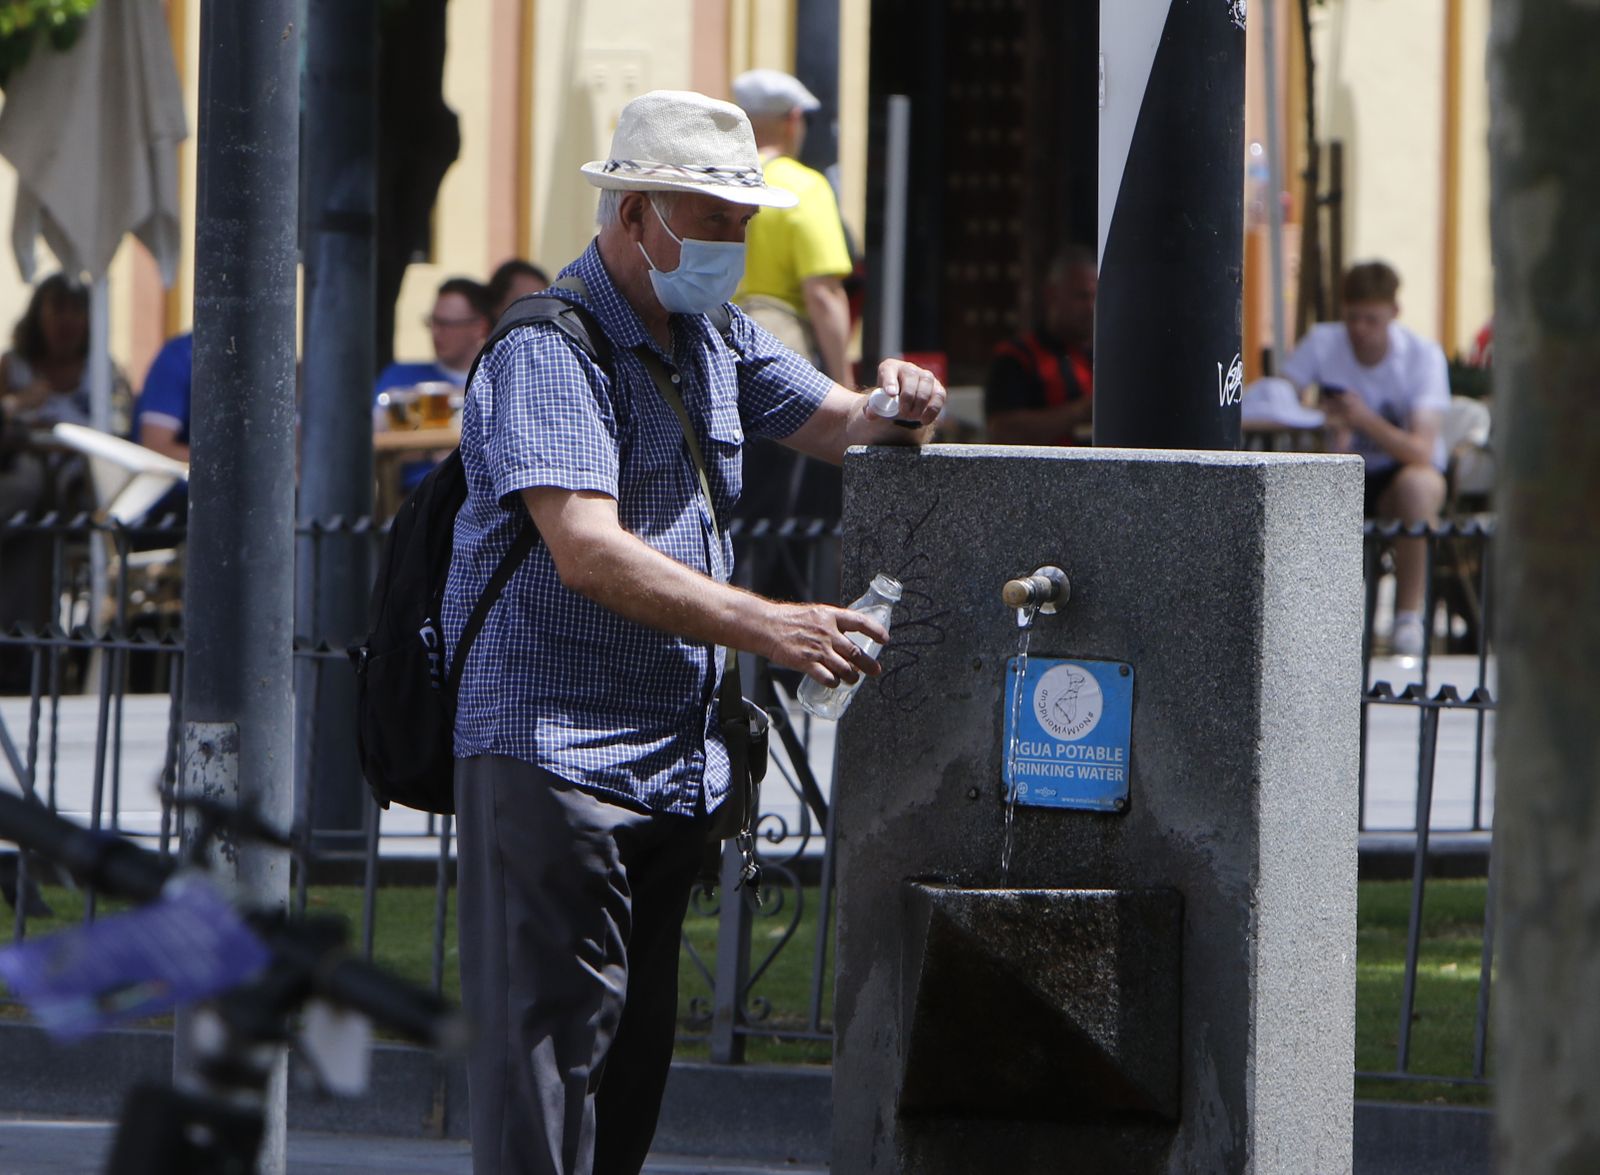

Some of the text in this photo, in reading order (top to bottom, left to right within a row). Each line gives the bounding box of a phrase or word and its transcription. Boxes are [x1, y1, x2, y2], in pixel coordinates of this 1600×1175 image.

[1039, 688, 1094, 736] #NotMyWorldCup
[1056, 744, 1123, 761] POTABLE
[1077, 766, 1124, 782] WATER
